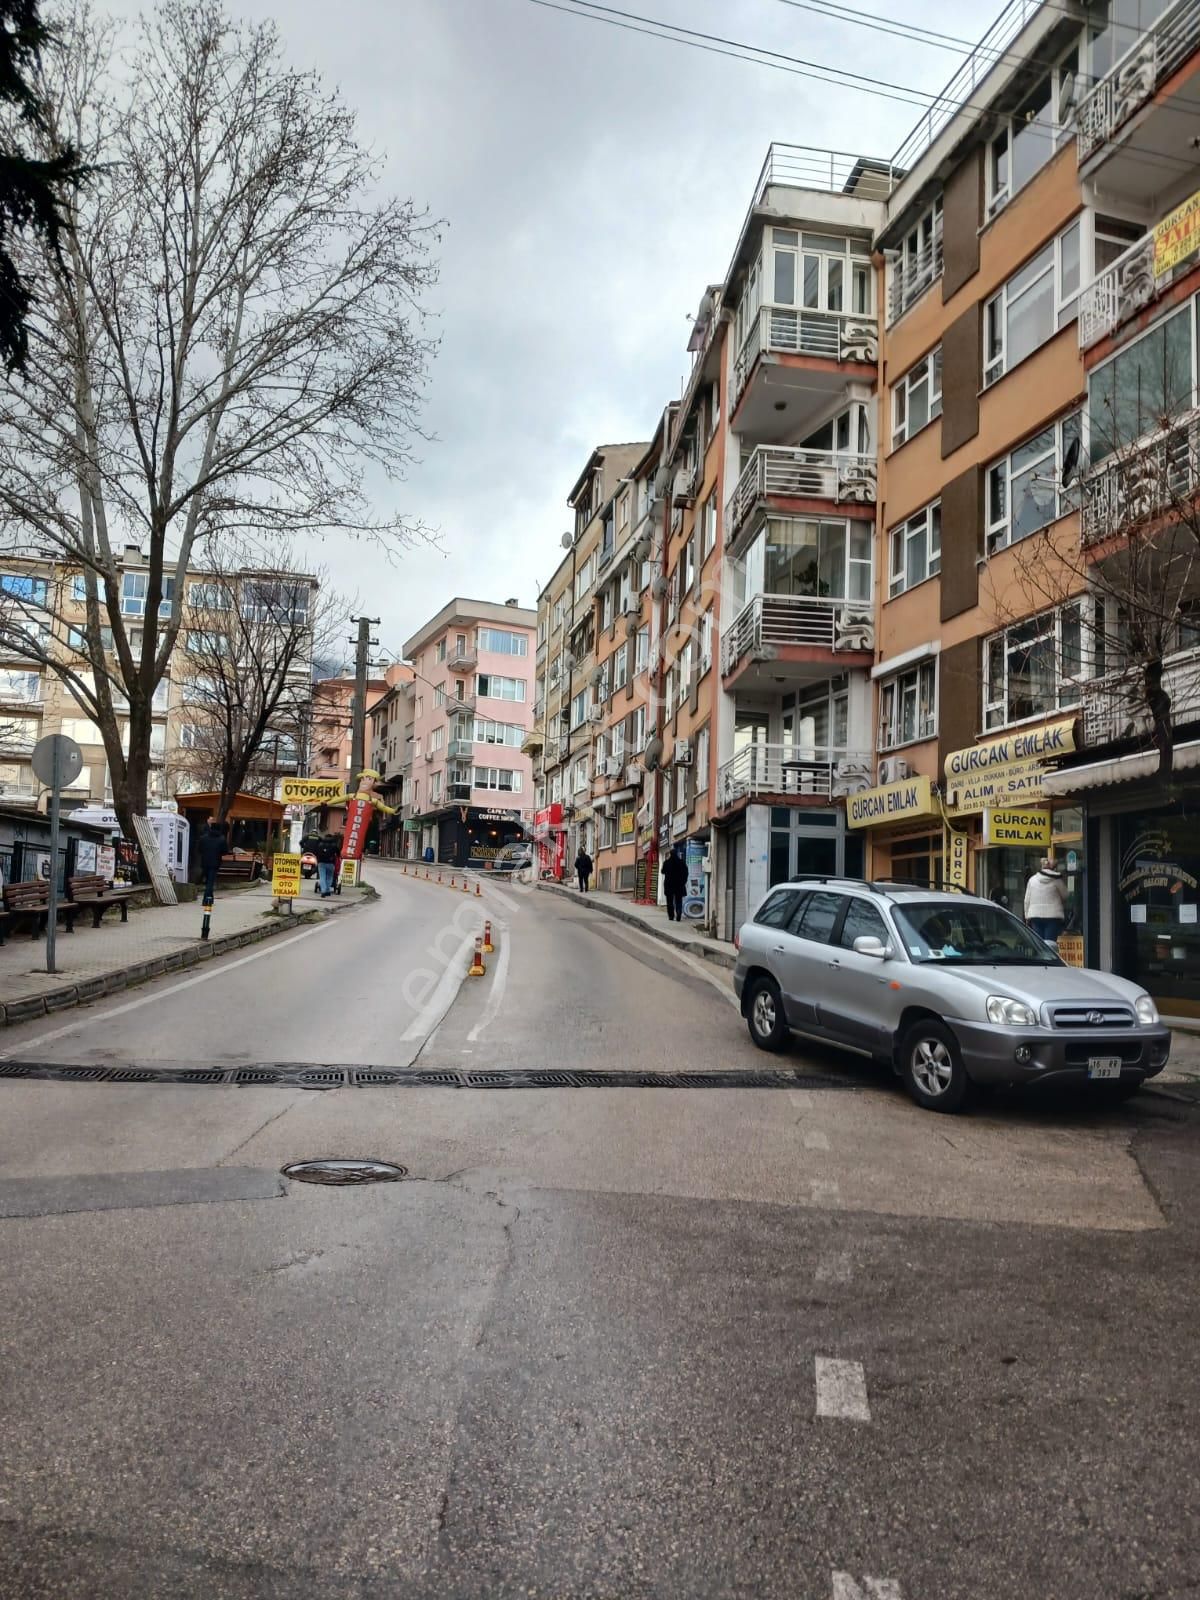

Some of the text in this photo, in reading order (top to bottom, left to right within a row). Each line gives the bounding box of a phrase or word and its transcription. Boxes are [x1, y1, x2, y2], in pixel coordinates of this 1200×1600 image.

[1014, 727, 1064, 758] EMLAK
[284, 784, 340, 798] OTOPARK
[964, 785, 994, 800] ALIM
[887, 786, 918, 812] EMLAK
[993, 812, 1046, 826] GÜRCAN
[347, 801, 366, 857] OTOPARK
[995, 829, 1043, 840] EMLAK
[274, 857, 300, 866] OTOPARK
